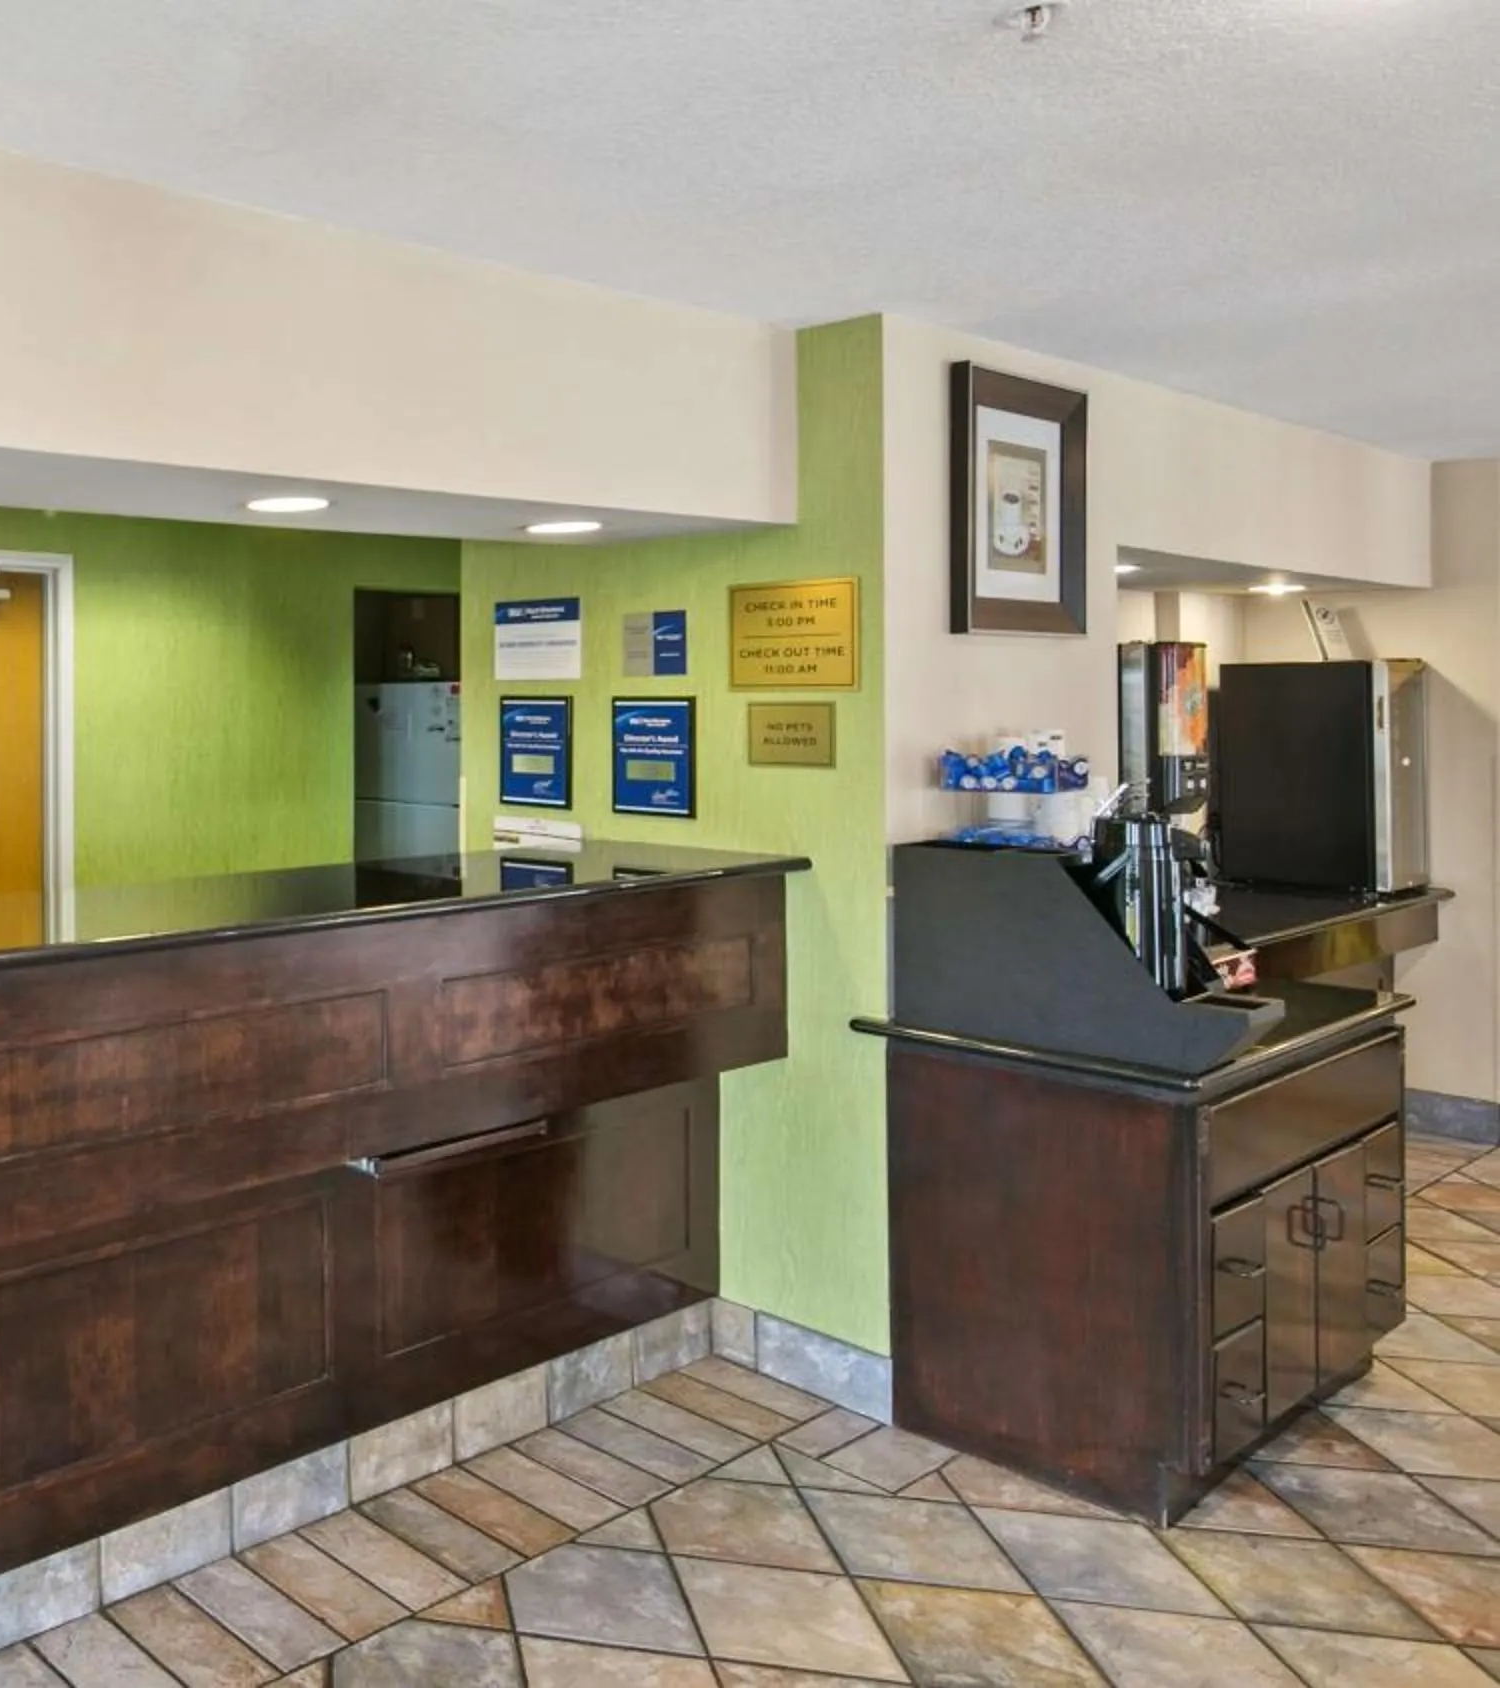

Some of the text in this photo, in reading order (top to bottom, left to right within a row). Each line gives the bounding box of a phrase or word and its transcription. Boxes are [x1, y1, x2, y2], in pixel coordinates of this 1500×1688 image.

[744, 597, 837, 613] CHECK IN TIME
[796, 615, 816, 625] PM
[739, 645, 845, 659] CHECK OUT TIME
[798, 663, 817, 673] AM
[766, 722, 814, 733] NO PETS
[763, 736, 817, 748] ALLOWED
